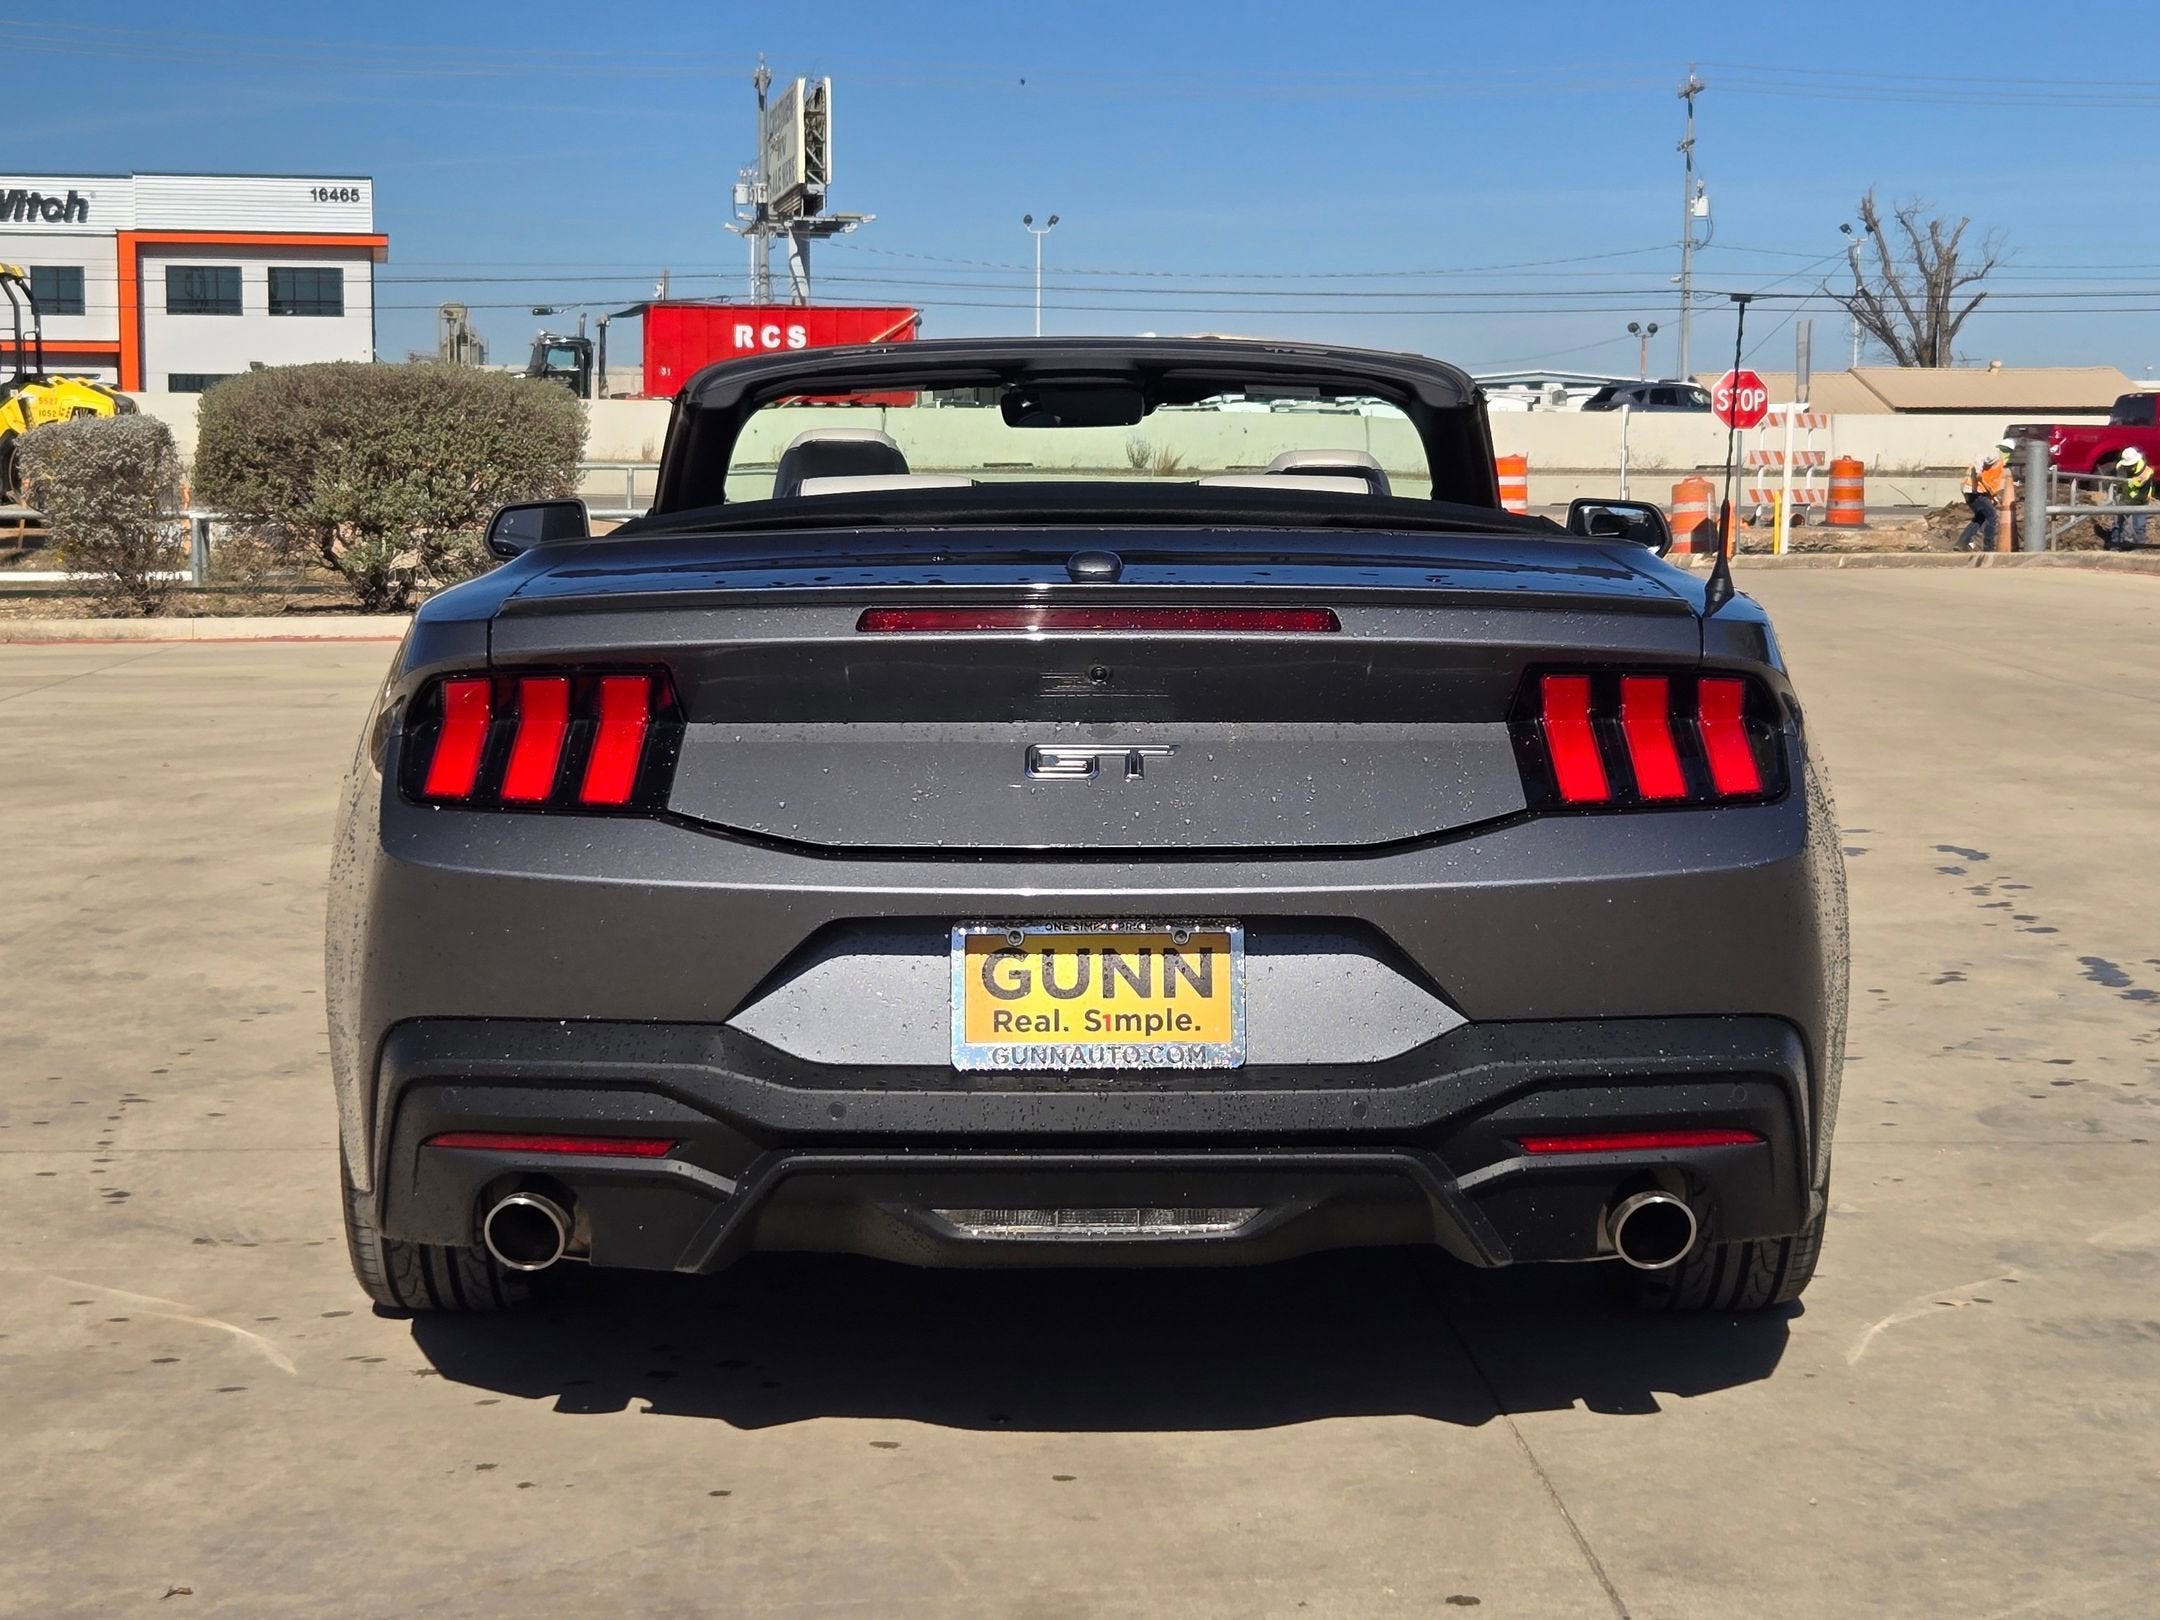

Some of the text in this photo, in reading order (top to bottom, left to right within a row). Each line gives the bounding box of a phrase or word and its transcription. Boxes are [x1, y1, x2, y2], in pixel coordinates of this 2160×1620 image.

[309, 187, 361, 203] 16465
[734, 324, 807, 349] RCS
[1716, 388, 1766, 412] STOP
[38, 409, 57, 418] 1052
[1025, 743, 1180, 782] GT
[1045, 922, 1070, 932] ONE
[982, 947, 1213, 1001] GUNN
[992, 1009, 1069, 1033] Real.
[991, 1045, 1208, 1065] GUNNAUTO.COM
